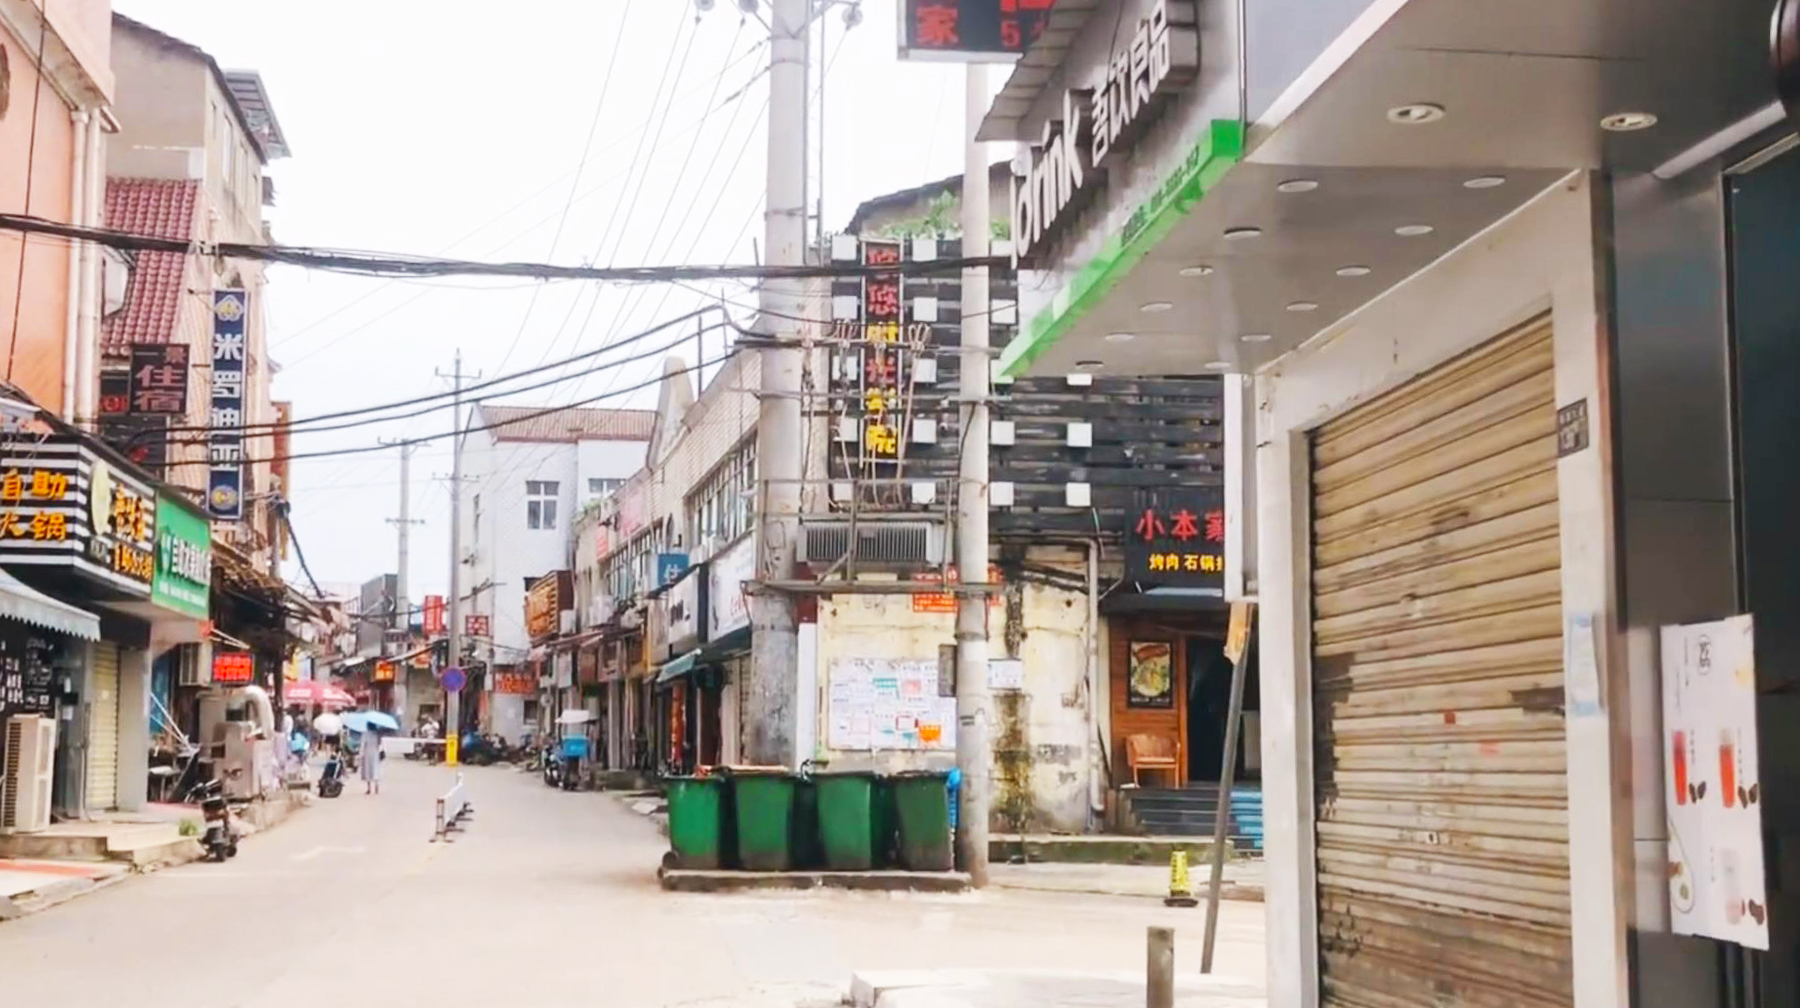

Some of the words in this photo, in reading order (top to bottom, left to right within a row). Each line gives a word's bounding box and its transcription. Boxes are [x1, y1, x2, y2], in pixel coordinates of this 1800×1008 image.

[133, 364, 185, 412] 住宿
[2, 467, 68, 500] 自助
[0, 509, 67, 541] 火锅
